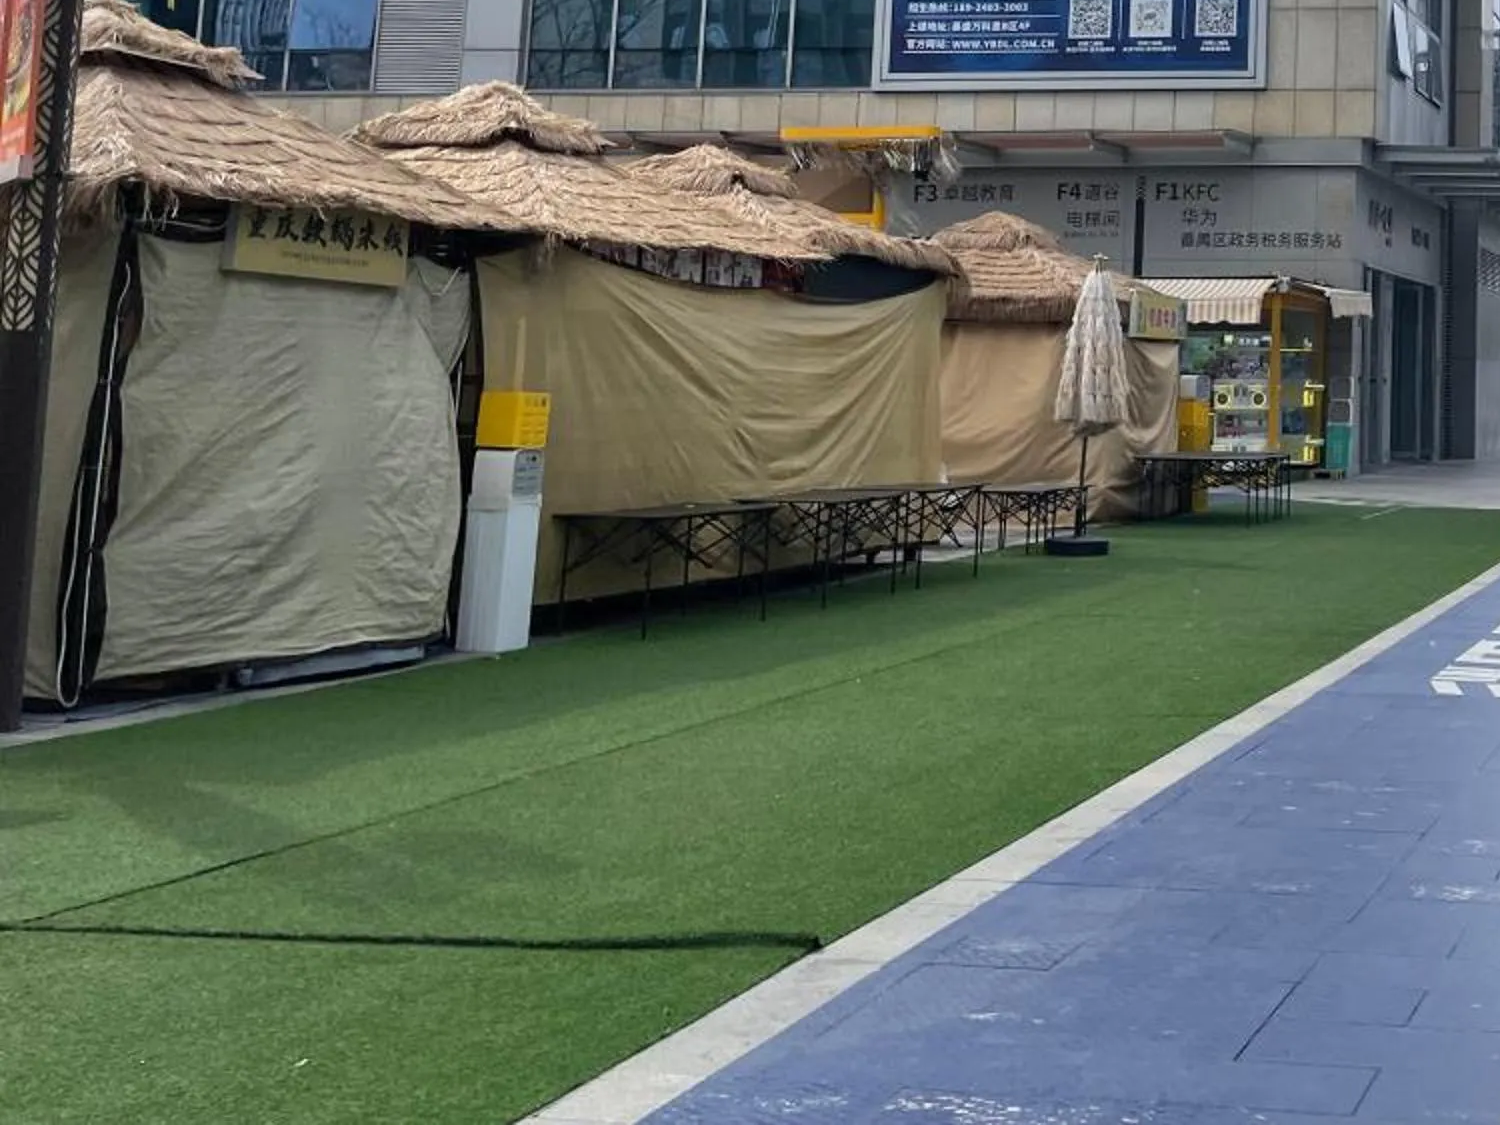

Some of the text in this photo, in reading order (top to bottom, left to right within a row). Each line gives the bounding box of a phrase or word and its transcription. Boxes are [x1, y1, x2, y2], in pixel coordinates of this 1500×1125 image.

[914, 184, 938, 203] F3
[1057, 182, 1082, 201] F4
[1155, 182, 1220, 202] F1 KFC
[1182, 208, 1217, 227] 华为
